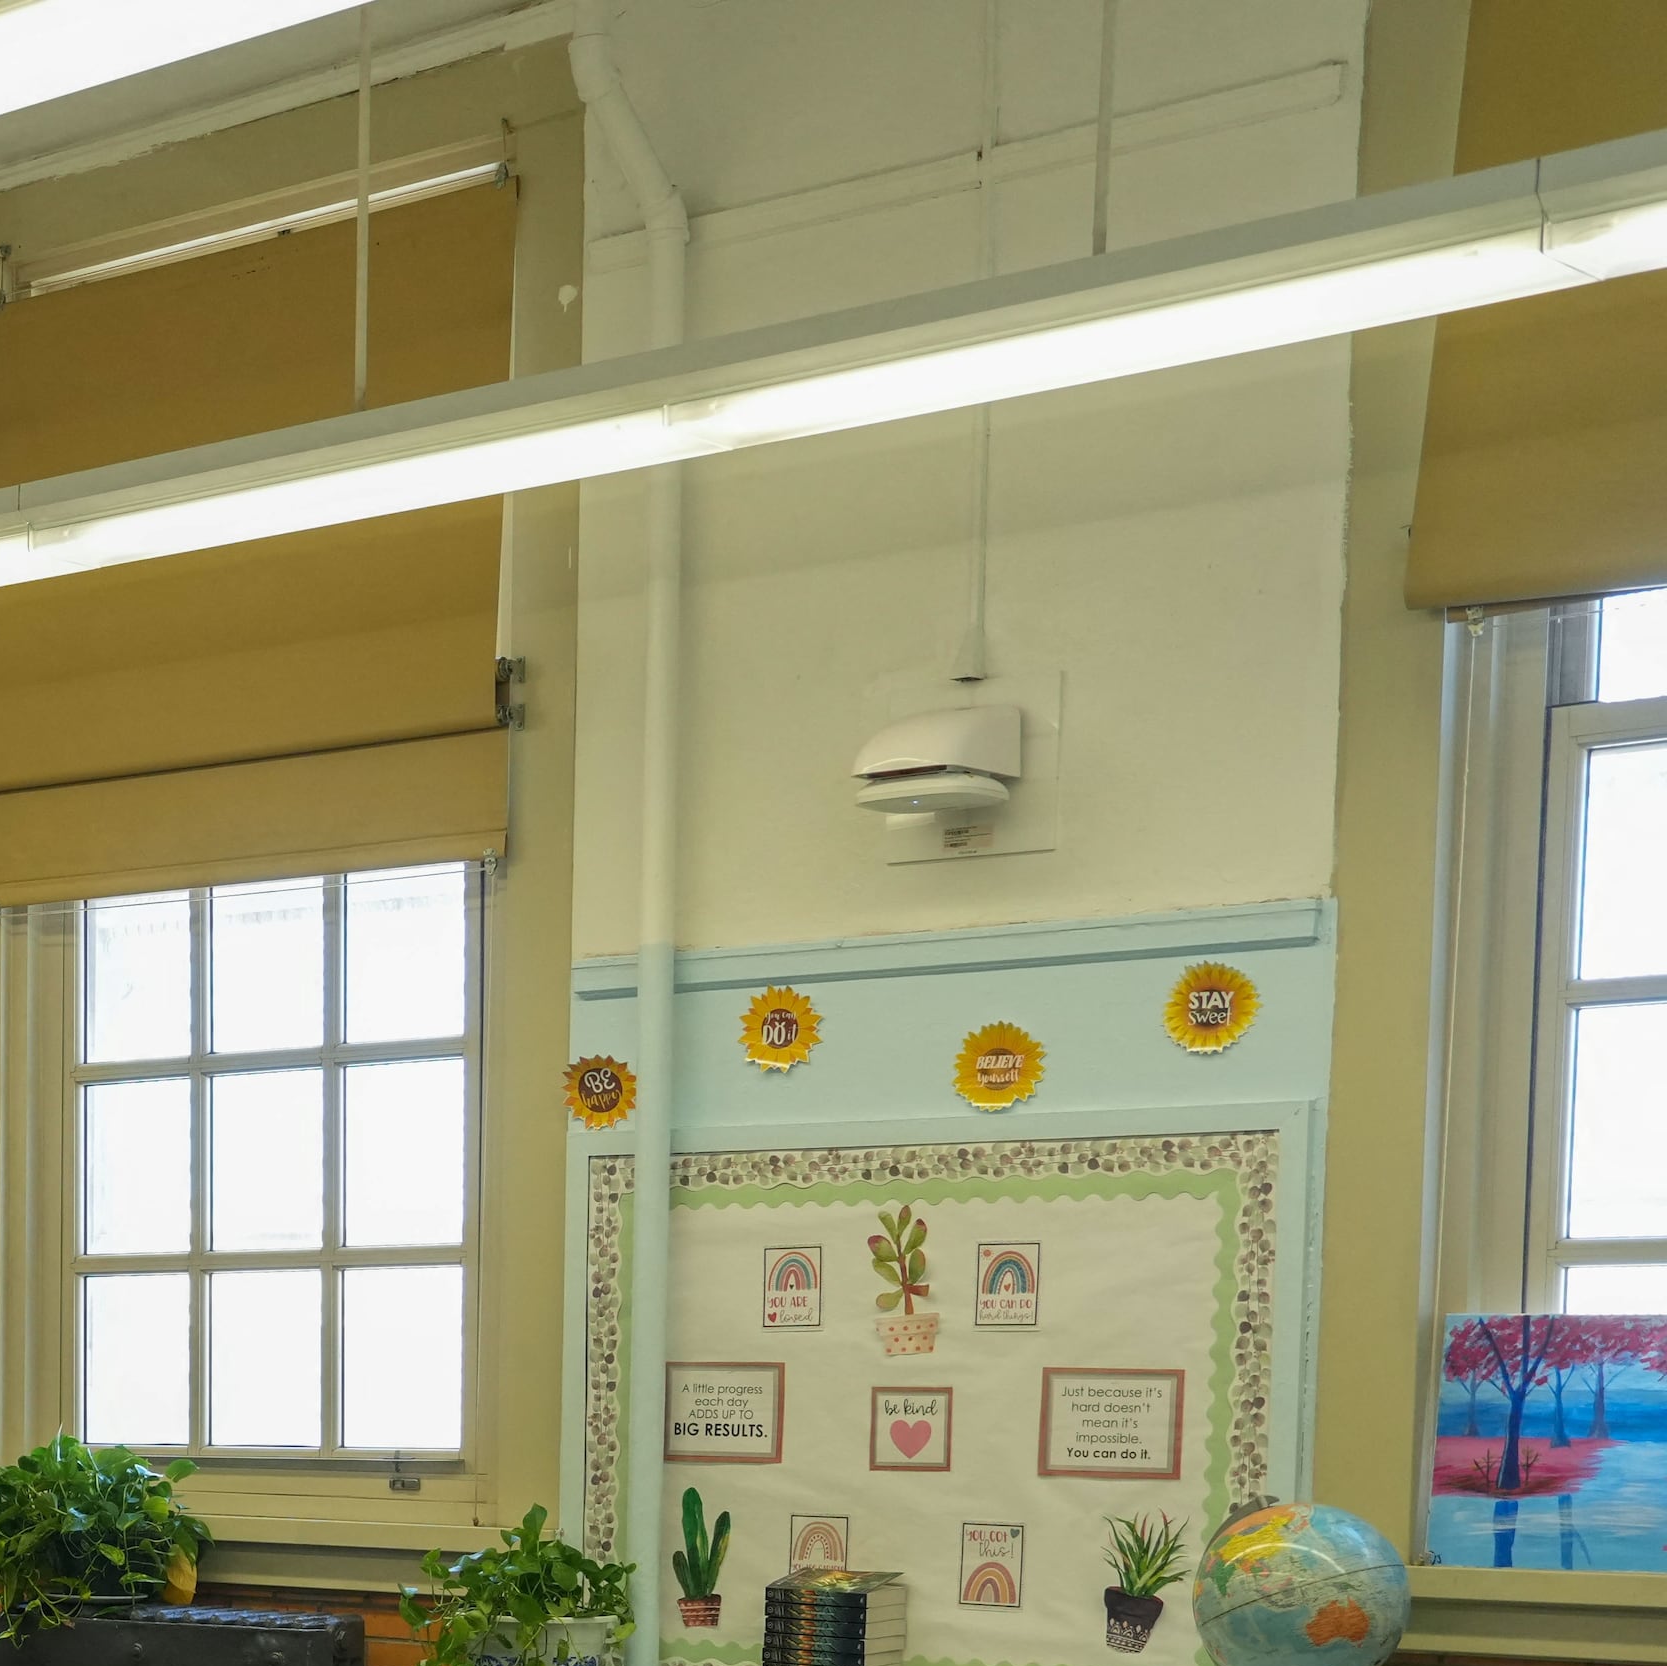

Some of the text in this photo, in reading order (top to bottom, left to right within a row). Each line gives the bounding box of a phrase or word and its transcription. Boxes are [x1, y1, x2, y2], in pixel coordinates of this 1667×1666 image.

[1188, 991, 1234, 1009] STAY
[763, 1021, 786, 1045] DO
[976, 1055, 1024, 1069] BELIEVE
[584, 1068, 616, 1093] BE
[768, 1296, 808, 1308] YOU ARE
[980, 1299, 1033, 1309] YOU CAN DO
[780, 1308, 814, 1323] loved
[682, 1384, 763, 1396] A little progress
[1062, 1387, 1163, 1398] Just because it's
[695, 1397, 748, 1408] each day
[884, 1399, 938, 1416] be kind
[1072, 1402, 1150, 1413] hard doesn't
[689, 1410, 753, 1420] ADDS UP TO
[1082, 1418, 1138, 1429] mean it's
[674, 1422, 768, 1438] BIG RESULTS.
[1076, 1432, 1142, 1445] impossible.
[1067, 1447, 1151, 1460] You can do it.
[966, 1529, 986, 1541] YOU
